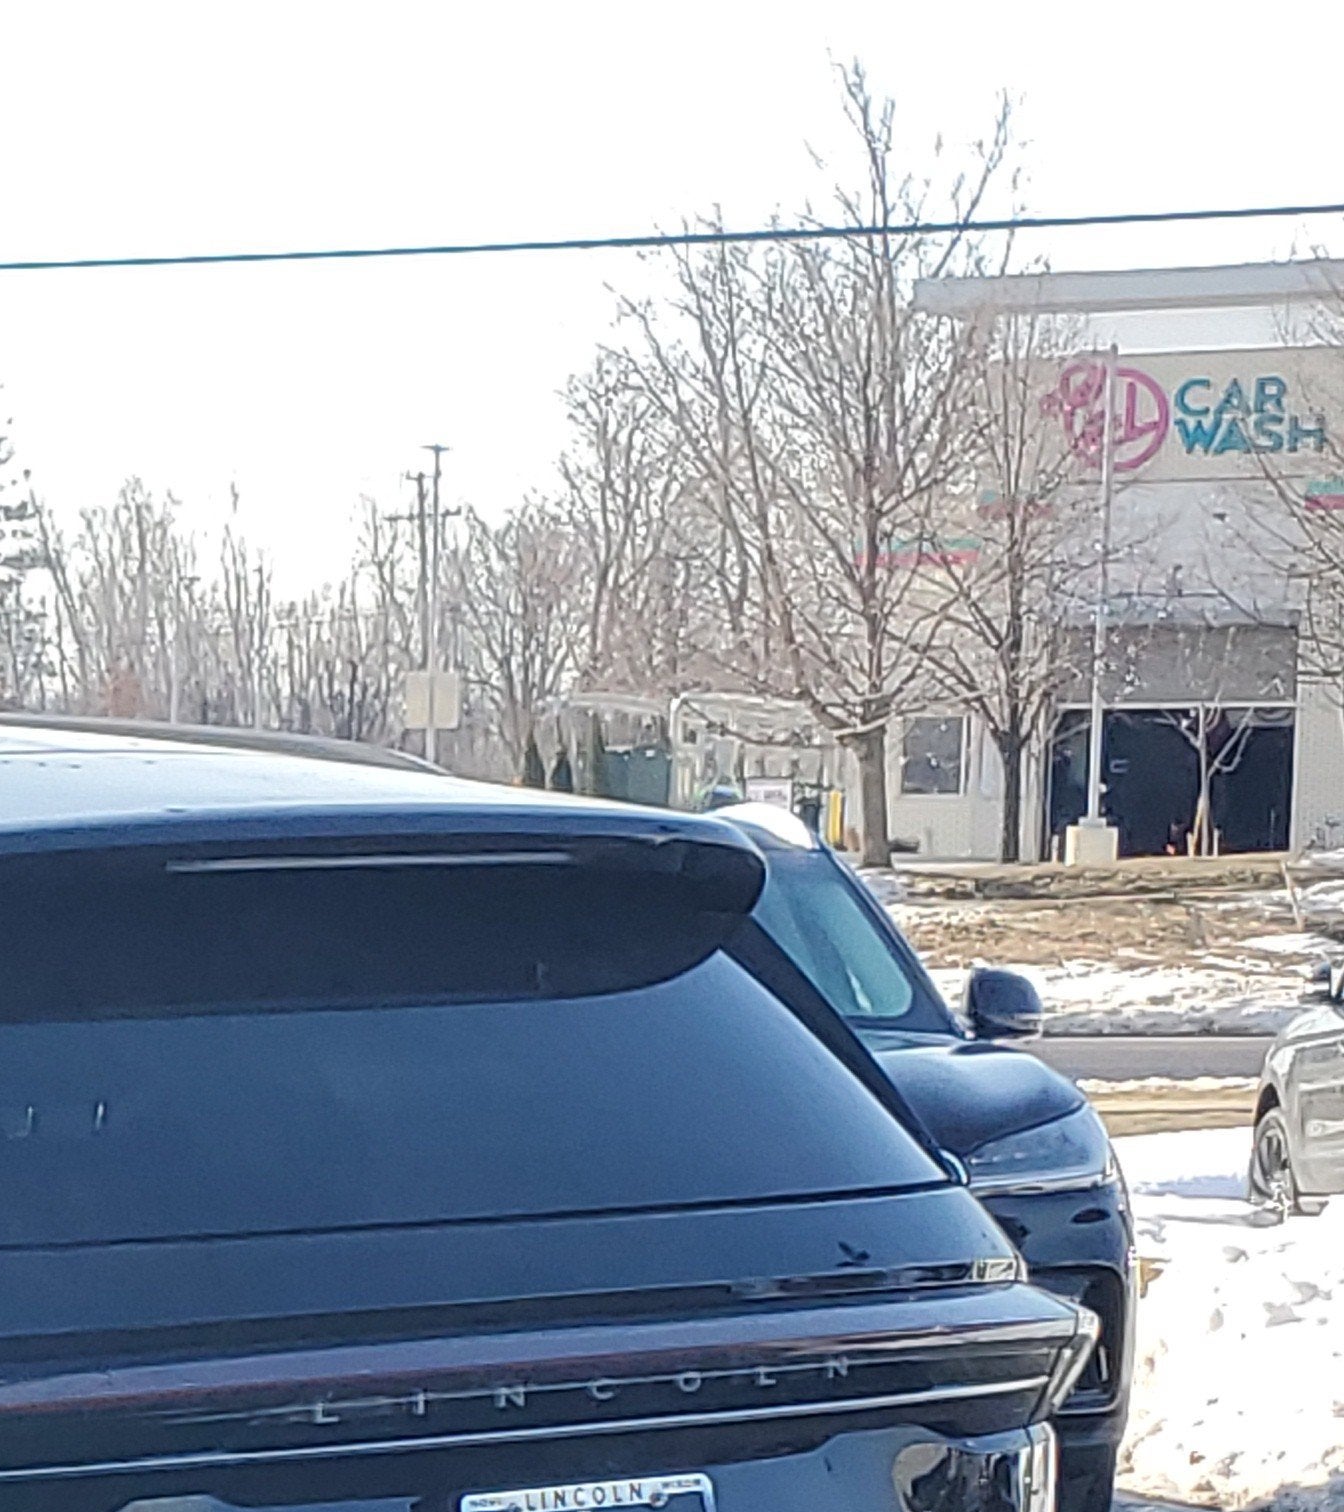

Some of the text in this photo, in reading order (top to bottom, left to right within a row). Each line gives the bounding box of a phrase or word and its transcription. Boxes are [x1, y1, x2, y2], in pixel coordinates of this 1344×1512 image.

[1173, 376, 1287, 417] CAR
[1173, 412, 1326, 456] WASH
[313, 1356, 850, 1425] LINCOLN
[524, 1482, 645, 1512] LINCOLN
